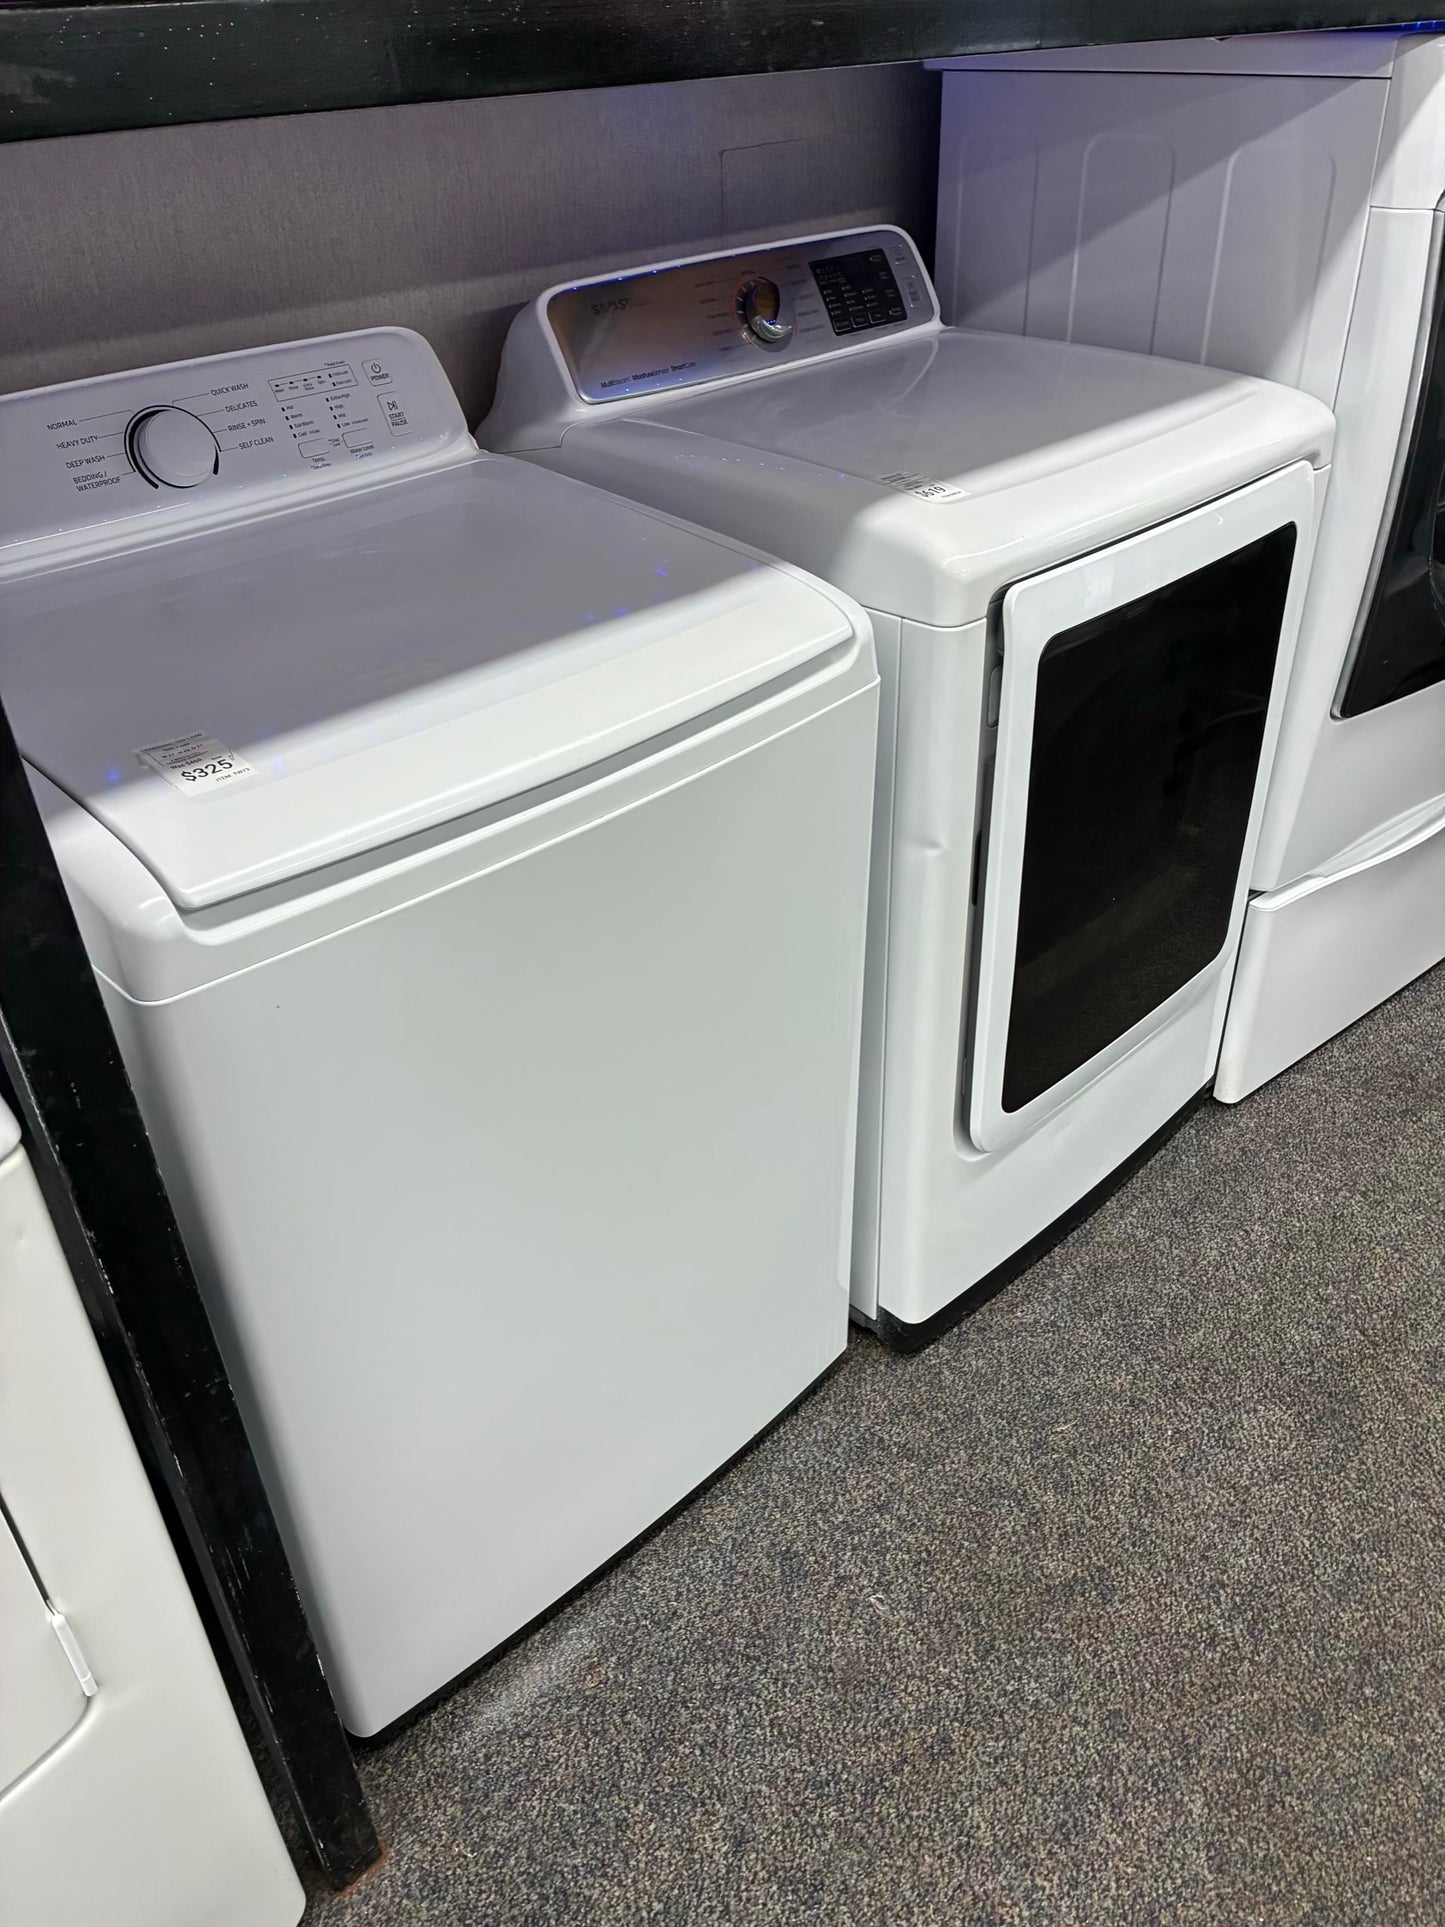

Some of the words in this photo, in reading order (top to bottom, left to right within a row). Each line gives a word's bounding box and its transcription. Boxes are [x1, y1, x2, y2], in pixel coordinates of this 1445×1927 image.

[370, 372, 389, 381] POWER
[210, 386, 230, 396] QUICK
[230, 382, 249, 392] WASH
[225, 400, 258, 413] DELICATES
[46, 419, 78, 431] NORMAL
[227, 422, 247, 431] RINSE
[250, 418, 267, 427] SPIN
[56, 439, 79, 450] HEAVY
[80, 435, 98, 446] DUTY
[238, 440, 254, 450] SELF
[253, 436, 274, 447] CLEAN
[65, 460, 84, 469] DEEP
[84, 455, 106, 465] WASH
[72, 471, 104, 485] BEDDING
[76, 476, 121, 492] WATERPROOF
[181, 758, 233, 782] $325
